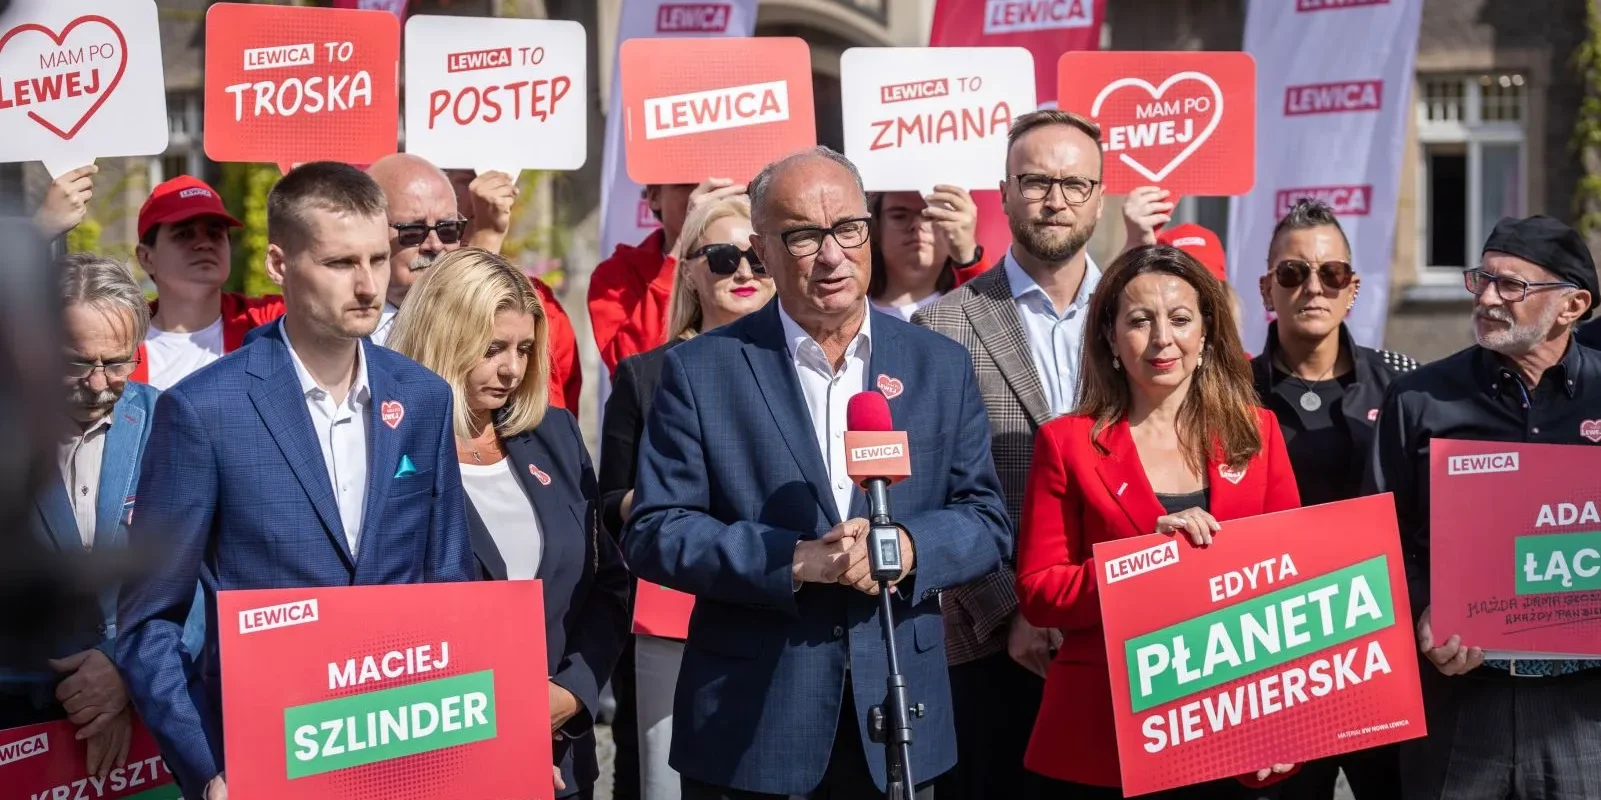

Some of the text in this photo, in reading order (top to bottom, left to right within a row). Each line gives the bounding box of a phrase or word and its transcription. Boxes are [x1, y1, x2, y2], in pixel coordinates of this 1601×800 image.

[991, 0, 1085, 25] LEWICA
[40, 43, 114, 69] MAM PO
[248, 41, 354, 66] LEWICA TO
[450, 47, 544, 70] LEWICA TO
[0, 68, 99, 109] LEWEJ
[224, 70, 372, 121] TROSKA
[428, 76, 571, 129] POSTĘP
[882, 76, 982, 101] LEWICA TO
[1289, 84, 1377, 112] LEWICA
[654, 88, 781, 130] LEWICA
[1136, 96, 1210, 119] MAM PO
[870, 101, 1012, 151] ZMIANA
[1101, 118, 1194, 151] EWEJ
[1580, 428, 1601, 436] LEWE
[855, 446, 900, 459] LEWICA
[1453, 455, 1515, 471] LEWICA
[1536, 501, 1601, 527] ADA
[1109, 545, 1176, 579] LEWICA
[1209, 553, 1299, 603] EDYTA
[244, 603, 315, 629] LEWICA
[1136, 574, 1382, 698] PŁANETA
[327, 641, 450, 690] MACIEJ
[1141, 640, 1392, 754] SIEWIERSKA
[294, 691, 489, 762] SZLINDER
[1372, 723, 1389, 732] NOWA
[1389, 719, 1409, 728] LEWICA
